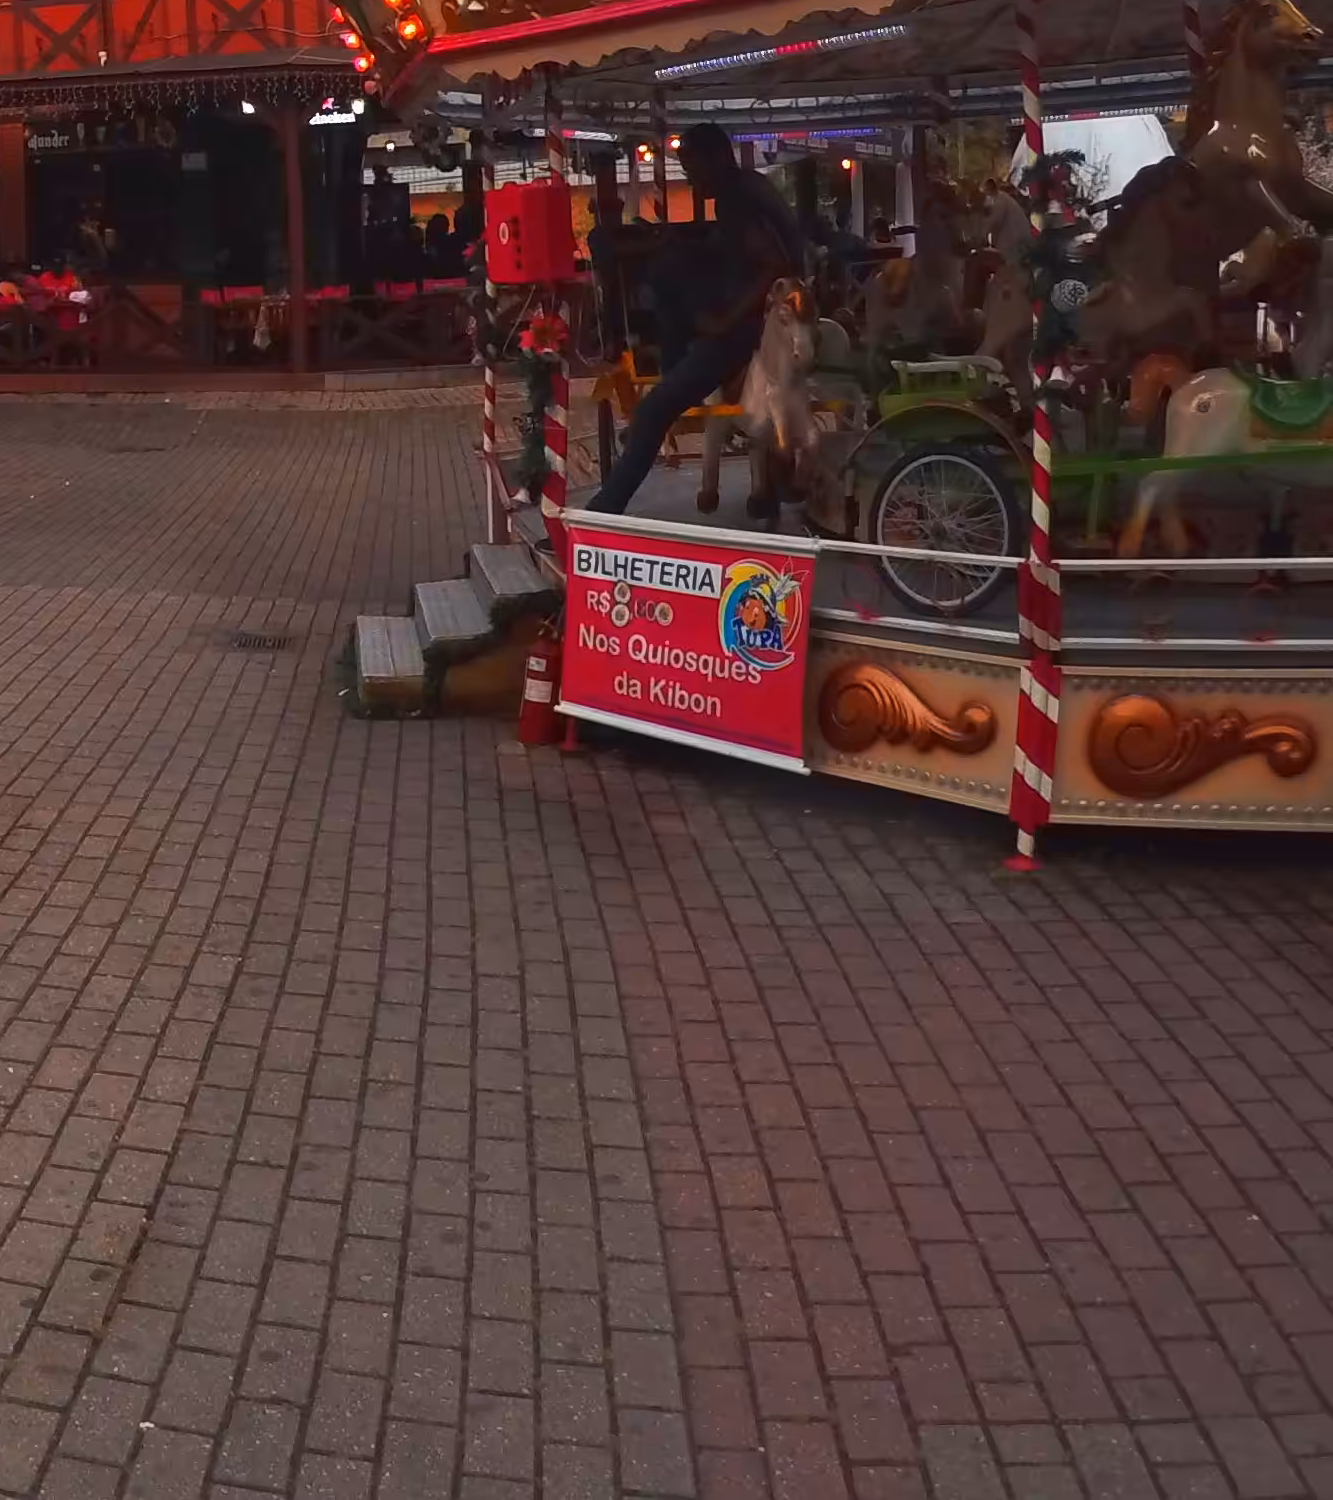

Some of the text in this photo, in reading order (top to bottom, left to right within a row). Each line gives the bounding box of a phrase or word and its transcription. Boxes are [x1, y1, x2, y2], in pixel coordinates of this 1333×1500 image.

[577, 548, 716, 593] BILHETERIA
[578, 623, 762, 684] Nos Quiosques
[614, 671, 722, 717] da Kibon
